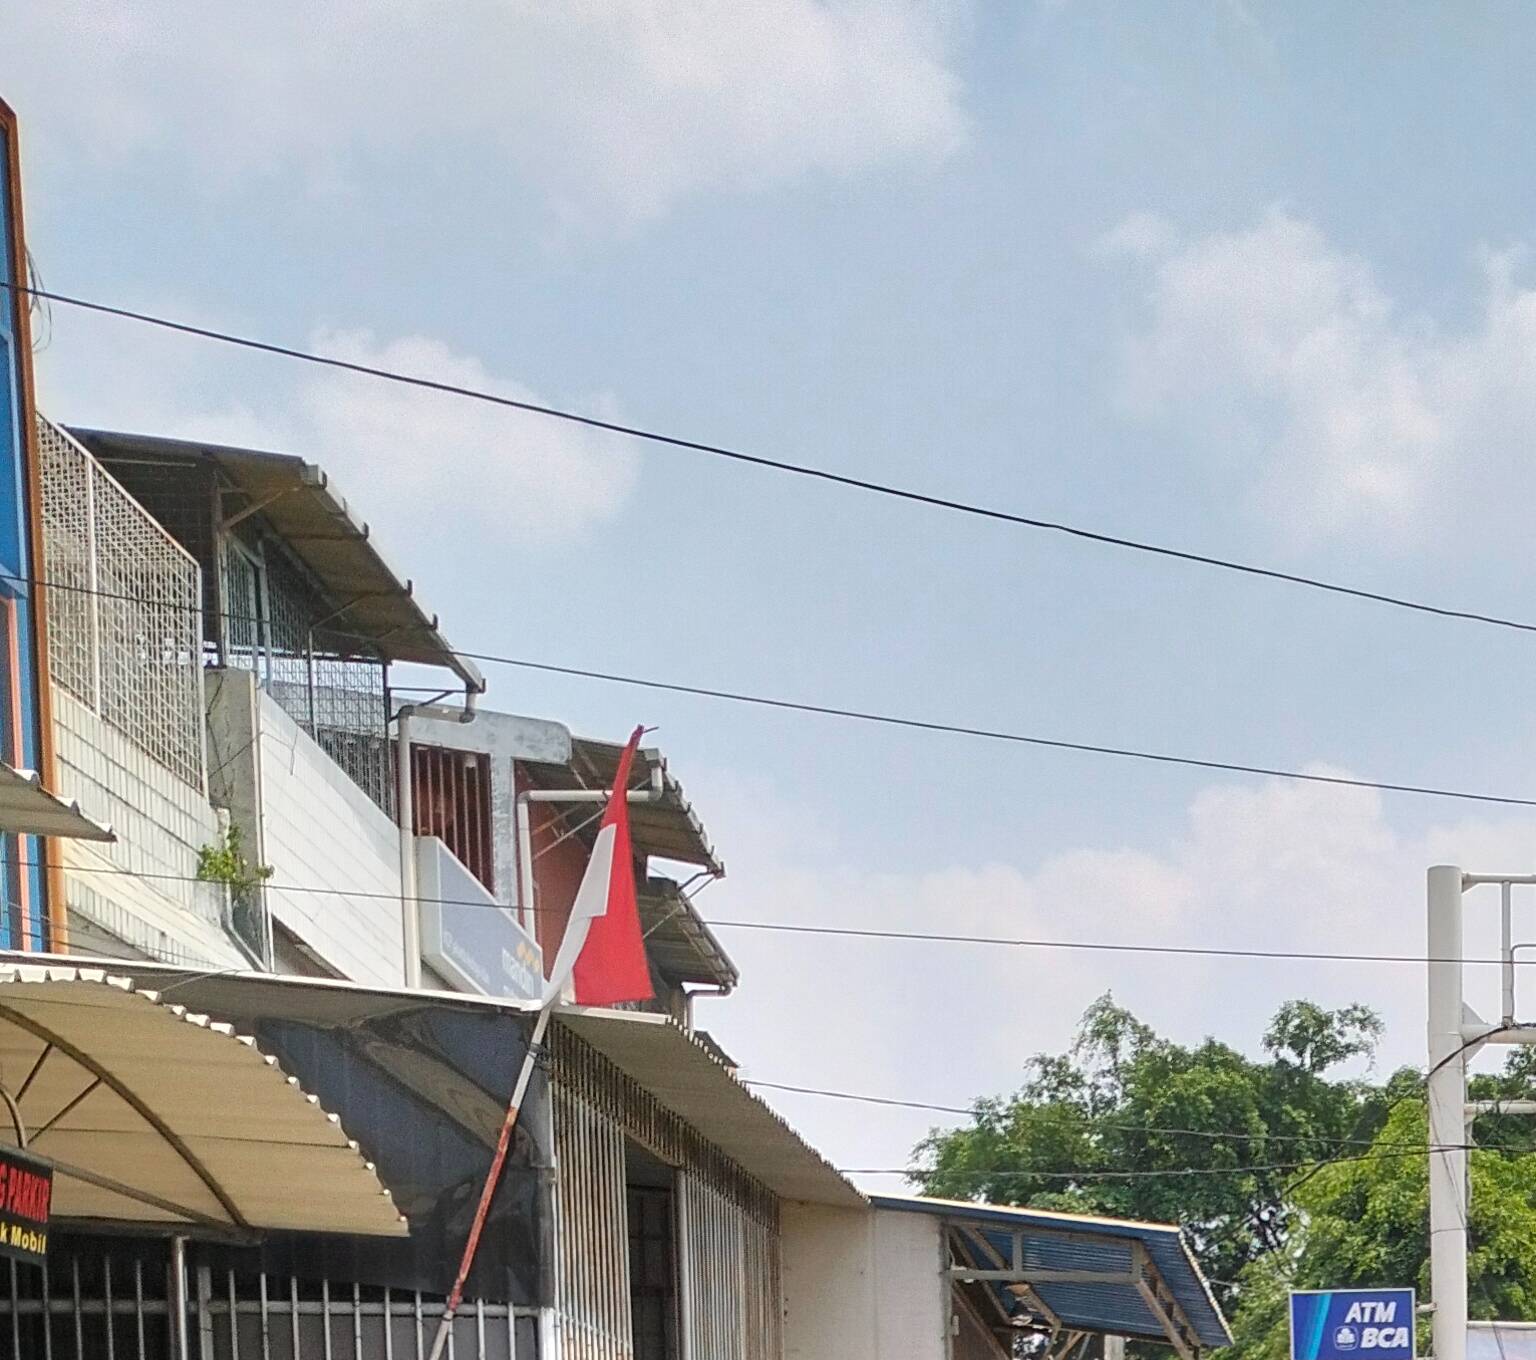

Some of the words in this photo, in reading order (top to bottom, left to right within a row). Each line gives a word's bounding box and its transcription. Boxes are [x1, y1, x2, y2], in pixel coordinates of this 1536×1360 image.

[10, 1225, 47, 1254] Mobil
[1344, 1301, 1397, 1323] ATM
[1361, 1327, 1409, 1348] BCA
